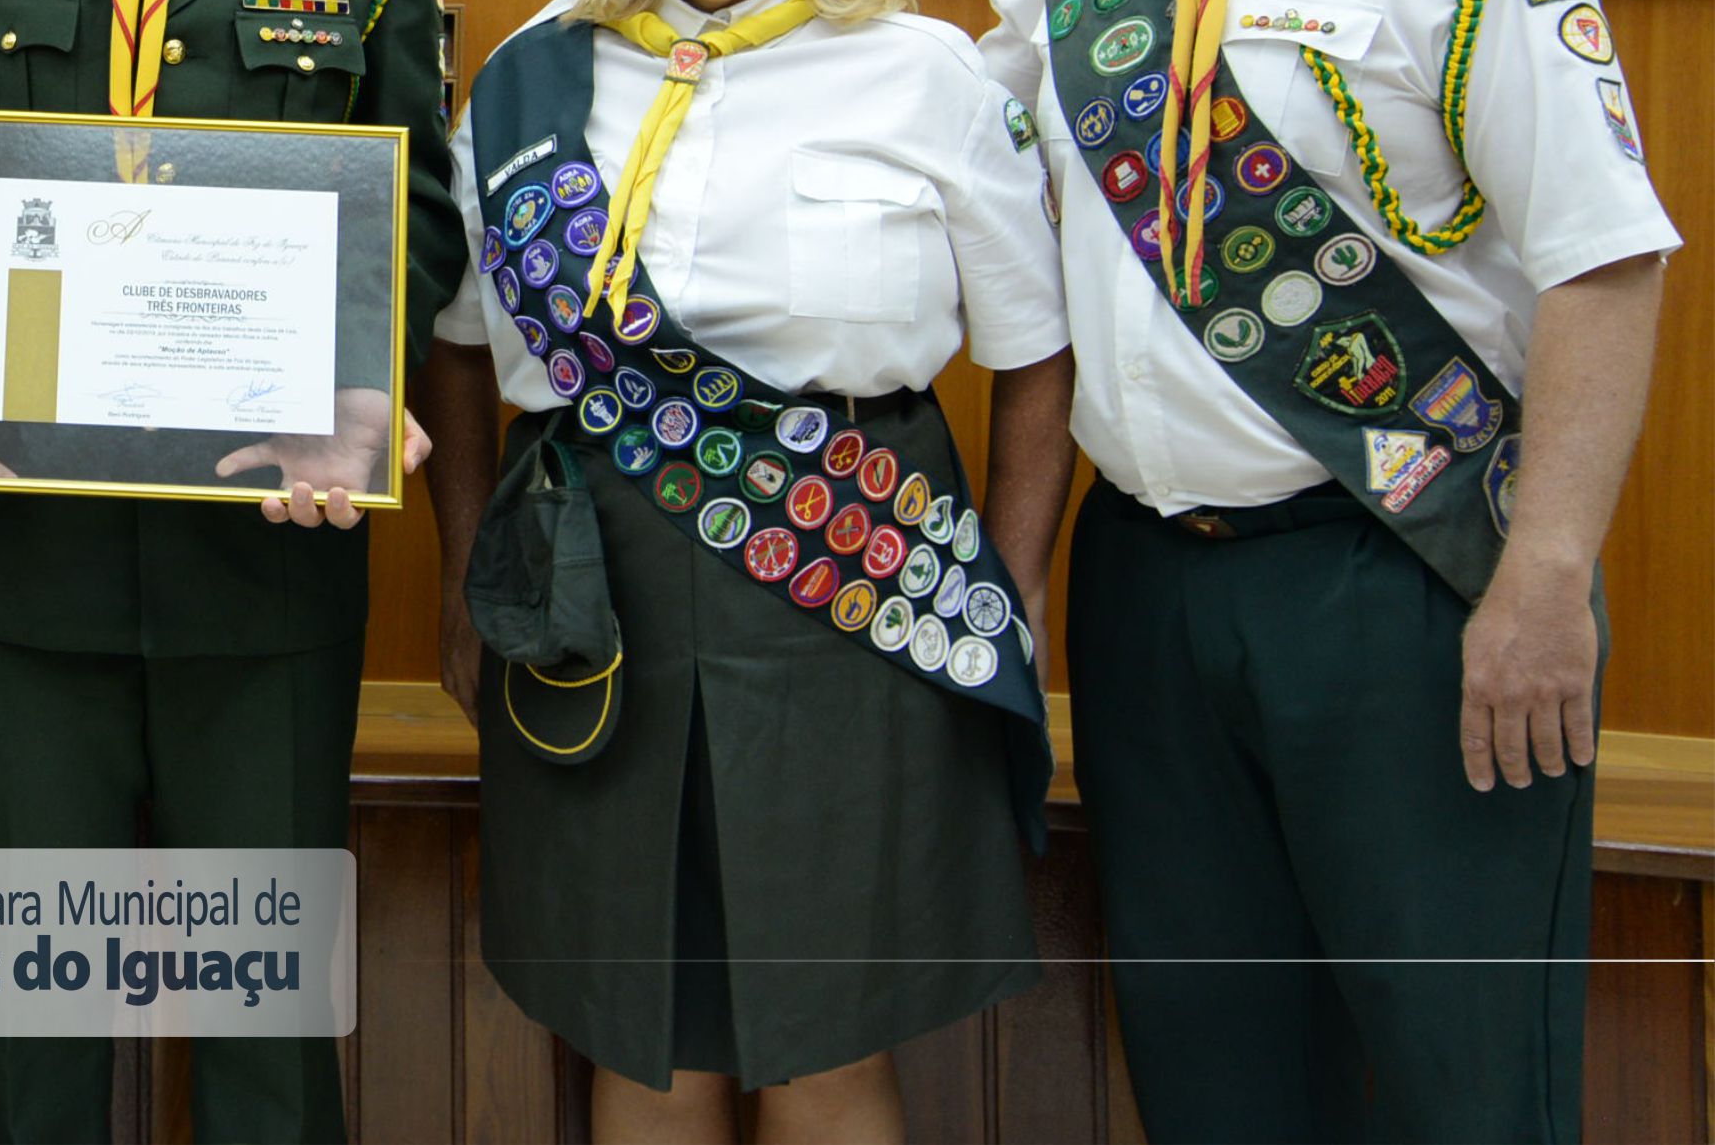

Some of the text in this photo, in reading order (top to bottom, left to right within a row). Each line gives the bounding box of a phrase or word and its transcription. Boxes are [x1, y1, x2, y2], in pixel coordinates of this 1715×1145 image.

[504, 151, 538, 178] VALDA
[123, 285, 268, 302] CLUBE DE DESBRAVADORES
[147, 299, 242, 315] TRÊS FRONTEIRAS
